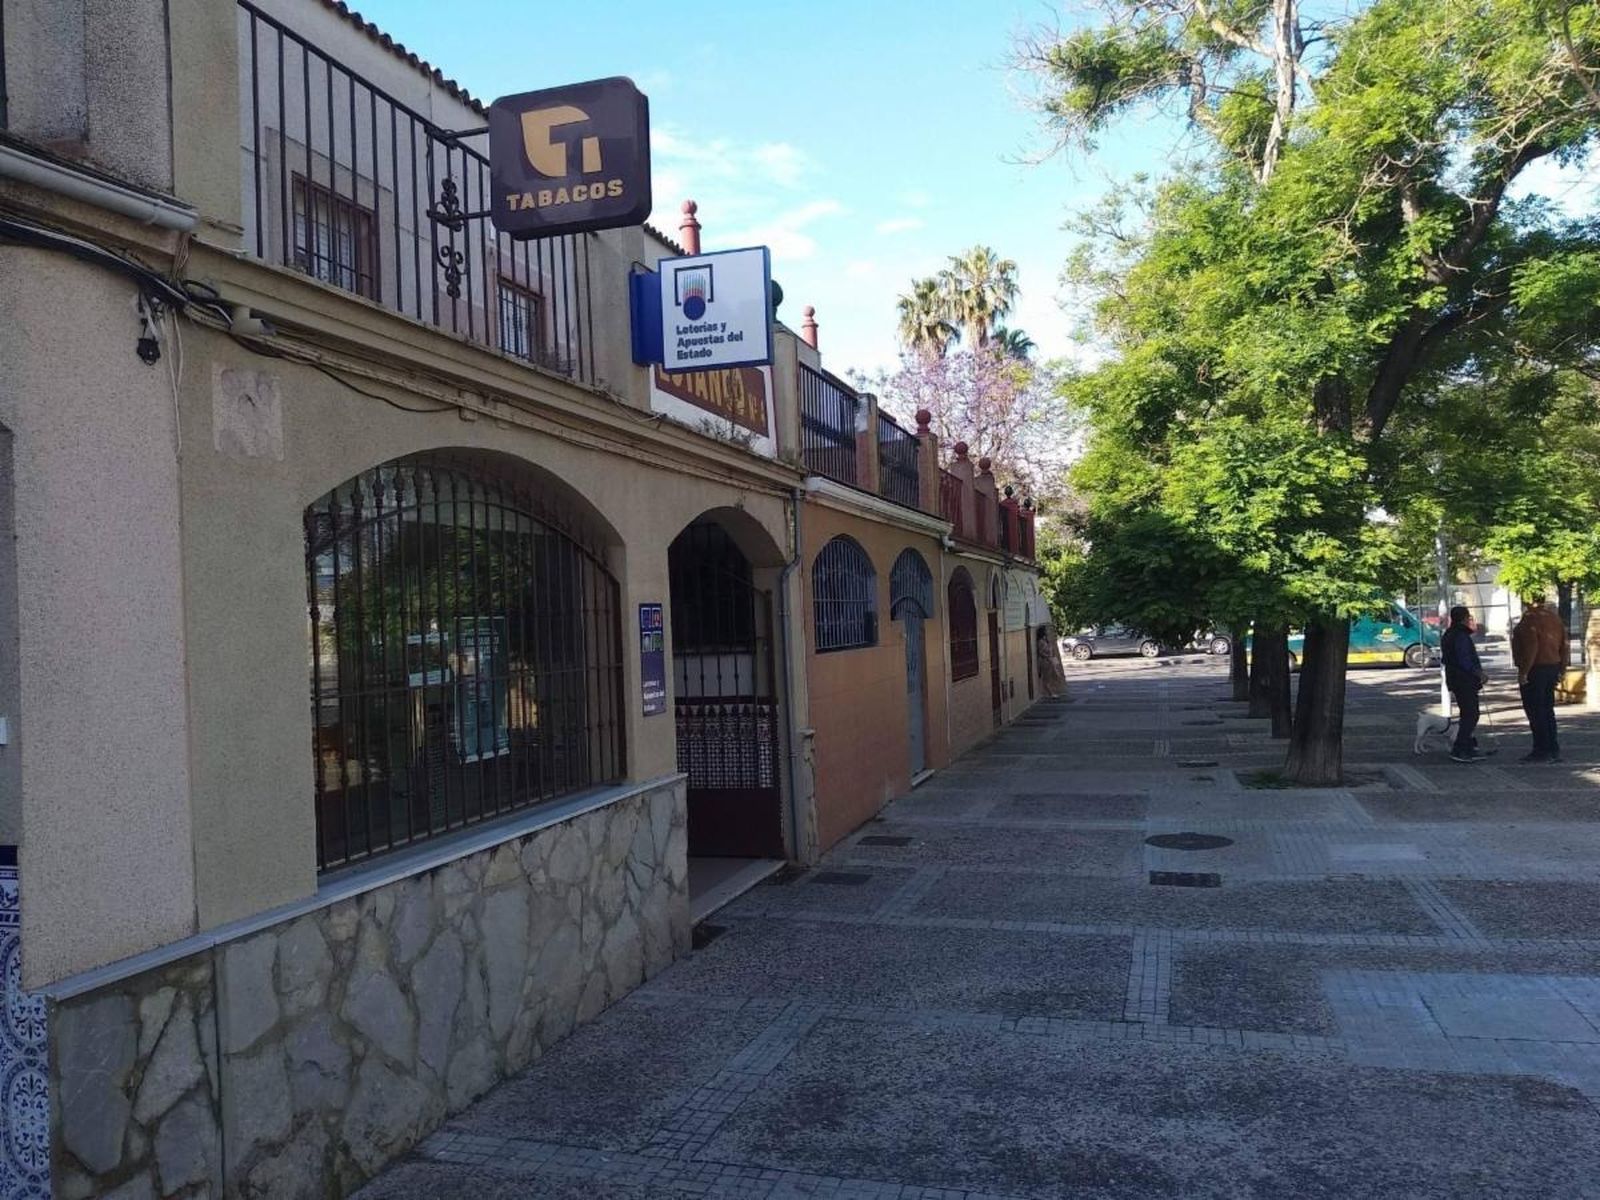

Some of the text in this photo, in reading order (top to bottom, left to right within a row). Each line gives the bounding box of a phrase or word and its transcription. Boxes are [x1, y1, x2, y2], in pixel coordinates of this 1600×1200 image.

[506, 179, 624, 211] TABACOS
[721, 322, 727, 333] y
[677, 330, 743, 348] Apuestas del
[677, 347, 713, 360] Estado
